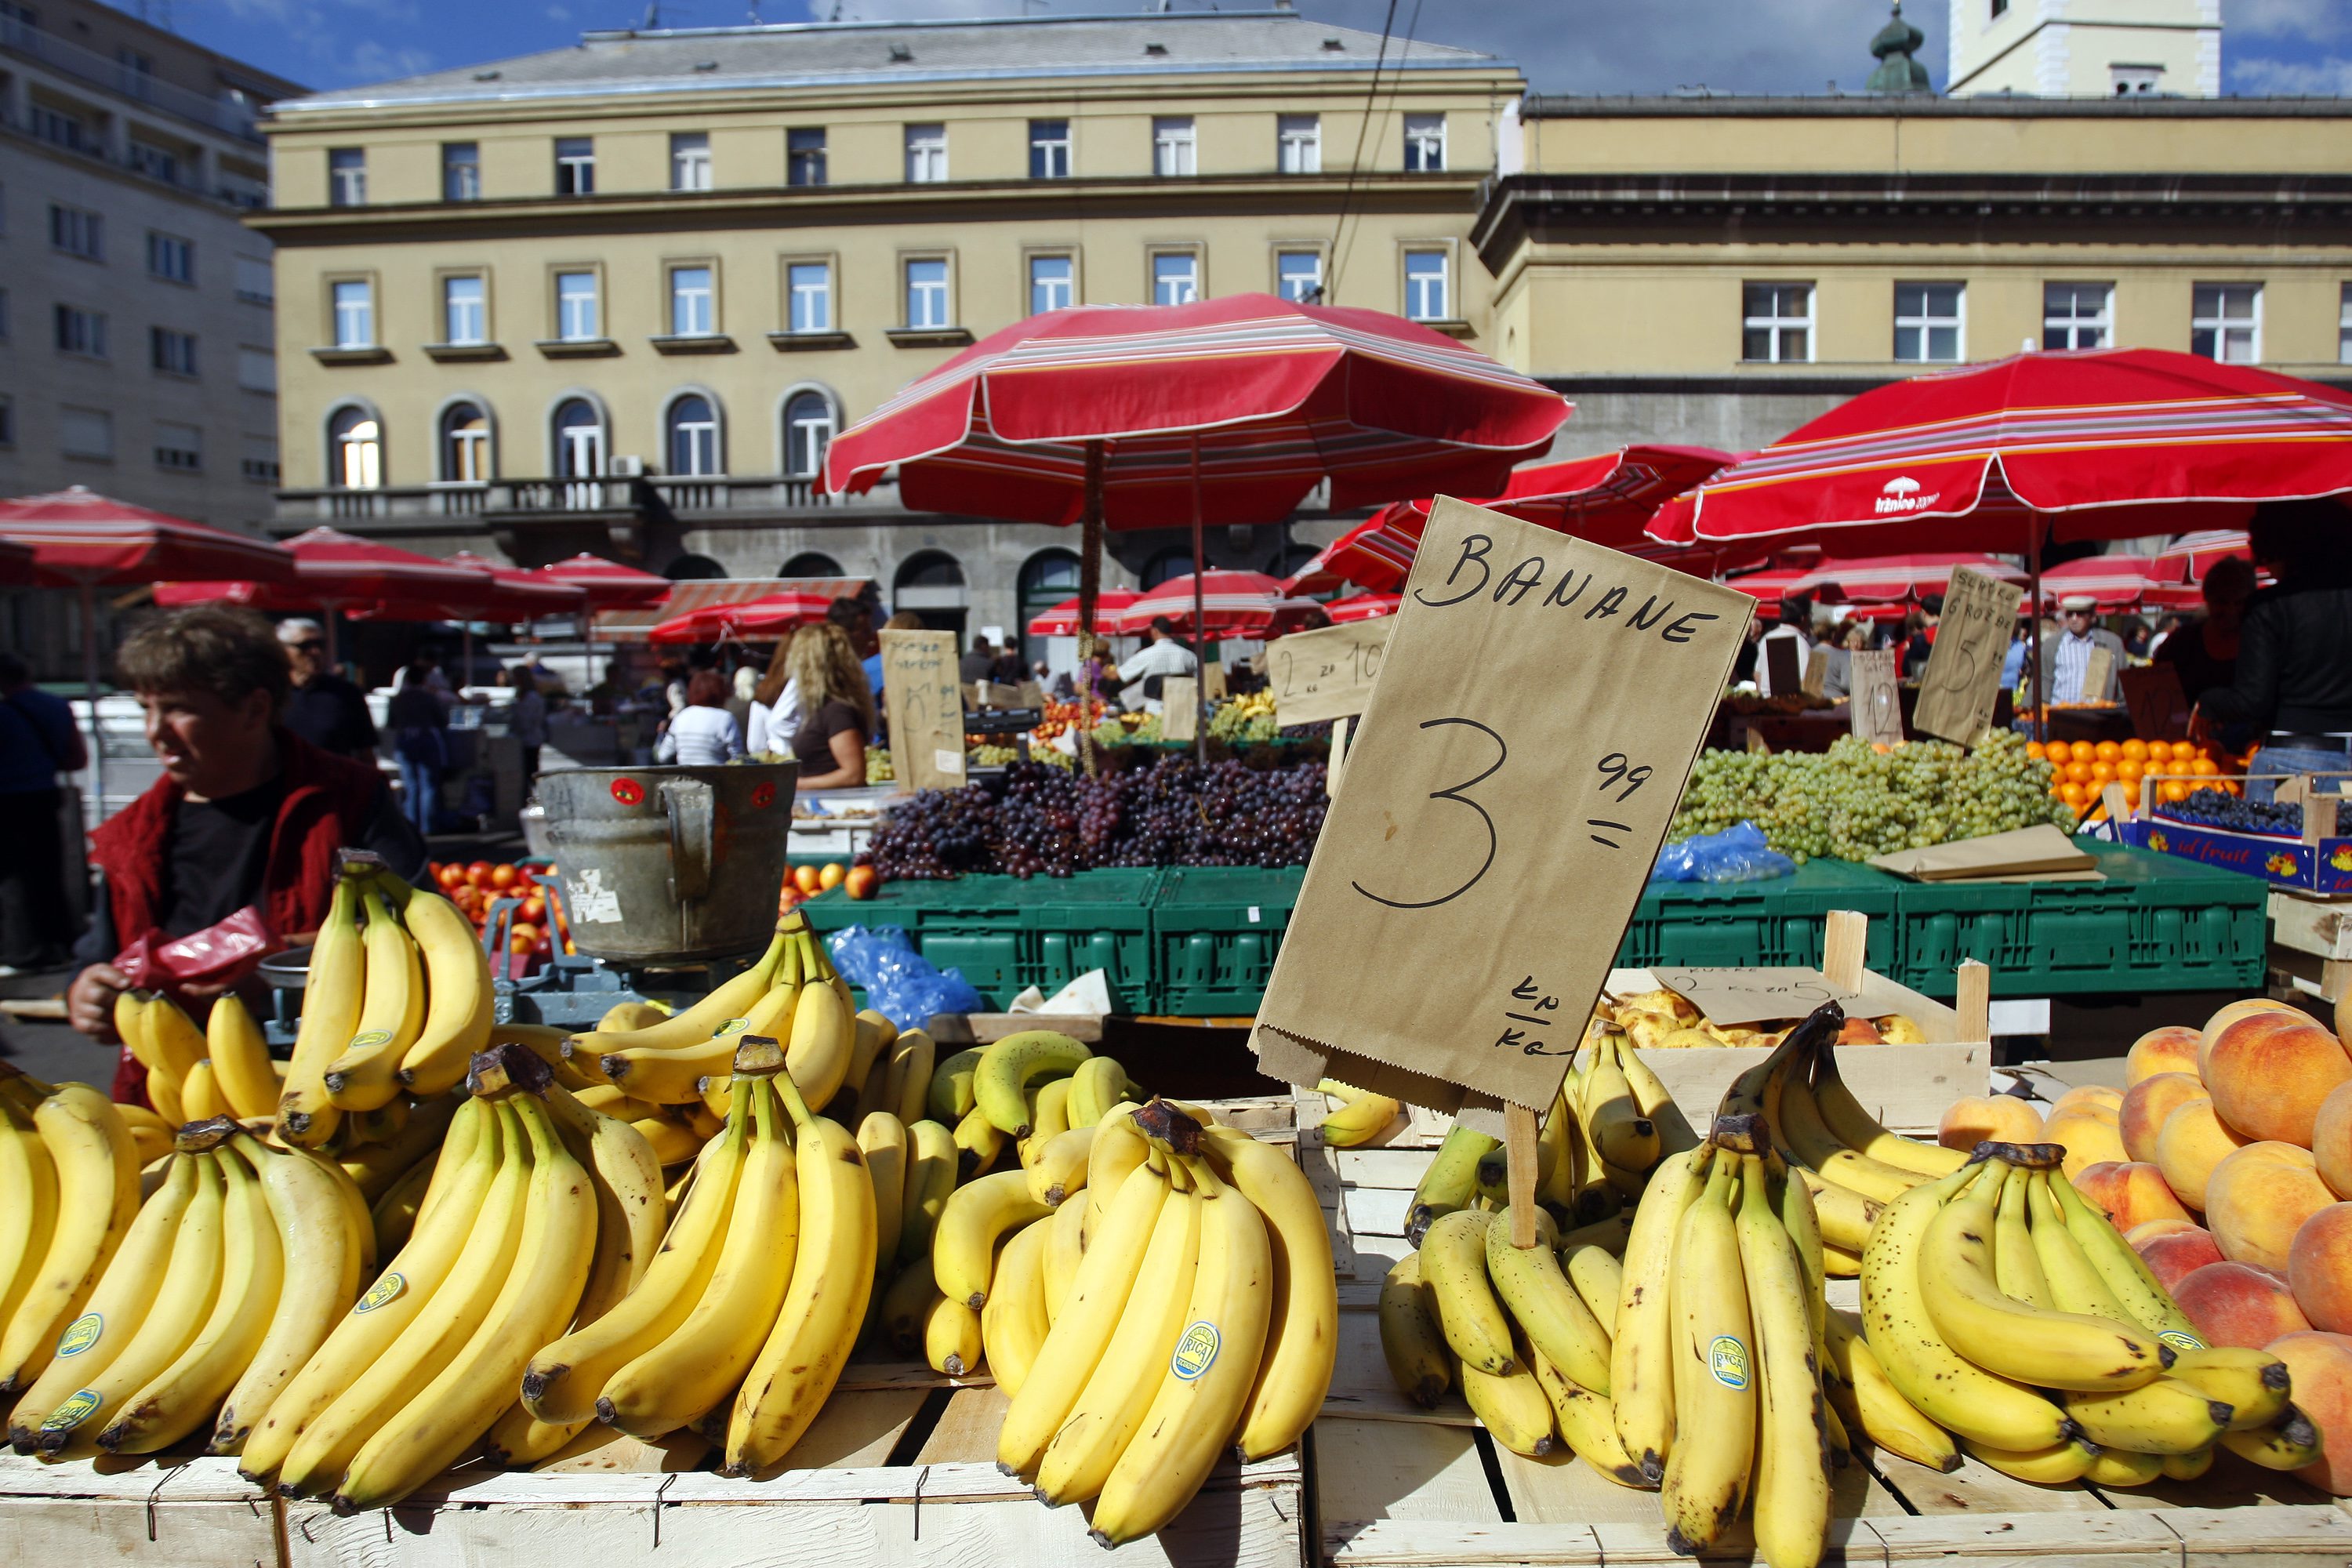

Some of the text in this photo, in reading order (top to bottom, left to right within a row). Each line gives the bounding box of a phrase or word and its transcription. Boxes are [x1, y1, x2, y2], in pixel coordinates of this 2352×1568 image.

[1414, 534, 1719, 643] BANANE
[1280, 650, 1296, 697] 2
[1941, 639, 1976, 693] 5
[1352, 717, 1653, 909] 3 99
[1675, 975, 1713, 992] 2
[1793, 981, 1831, 1001] 5
[1181, 1338, 1208, 1363] RICA
